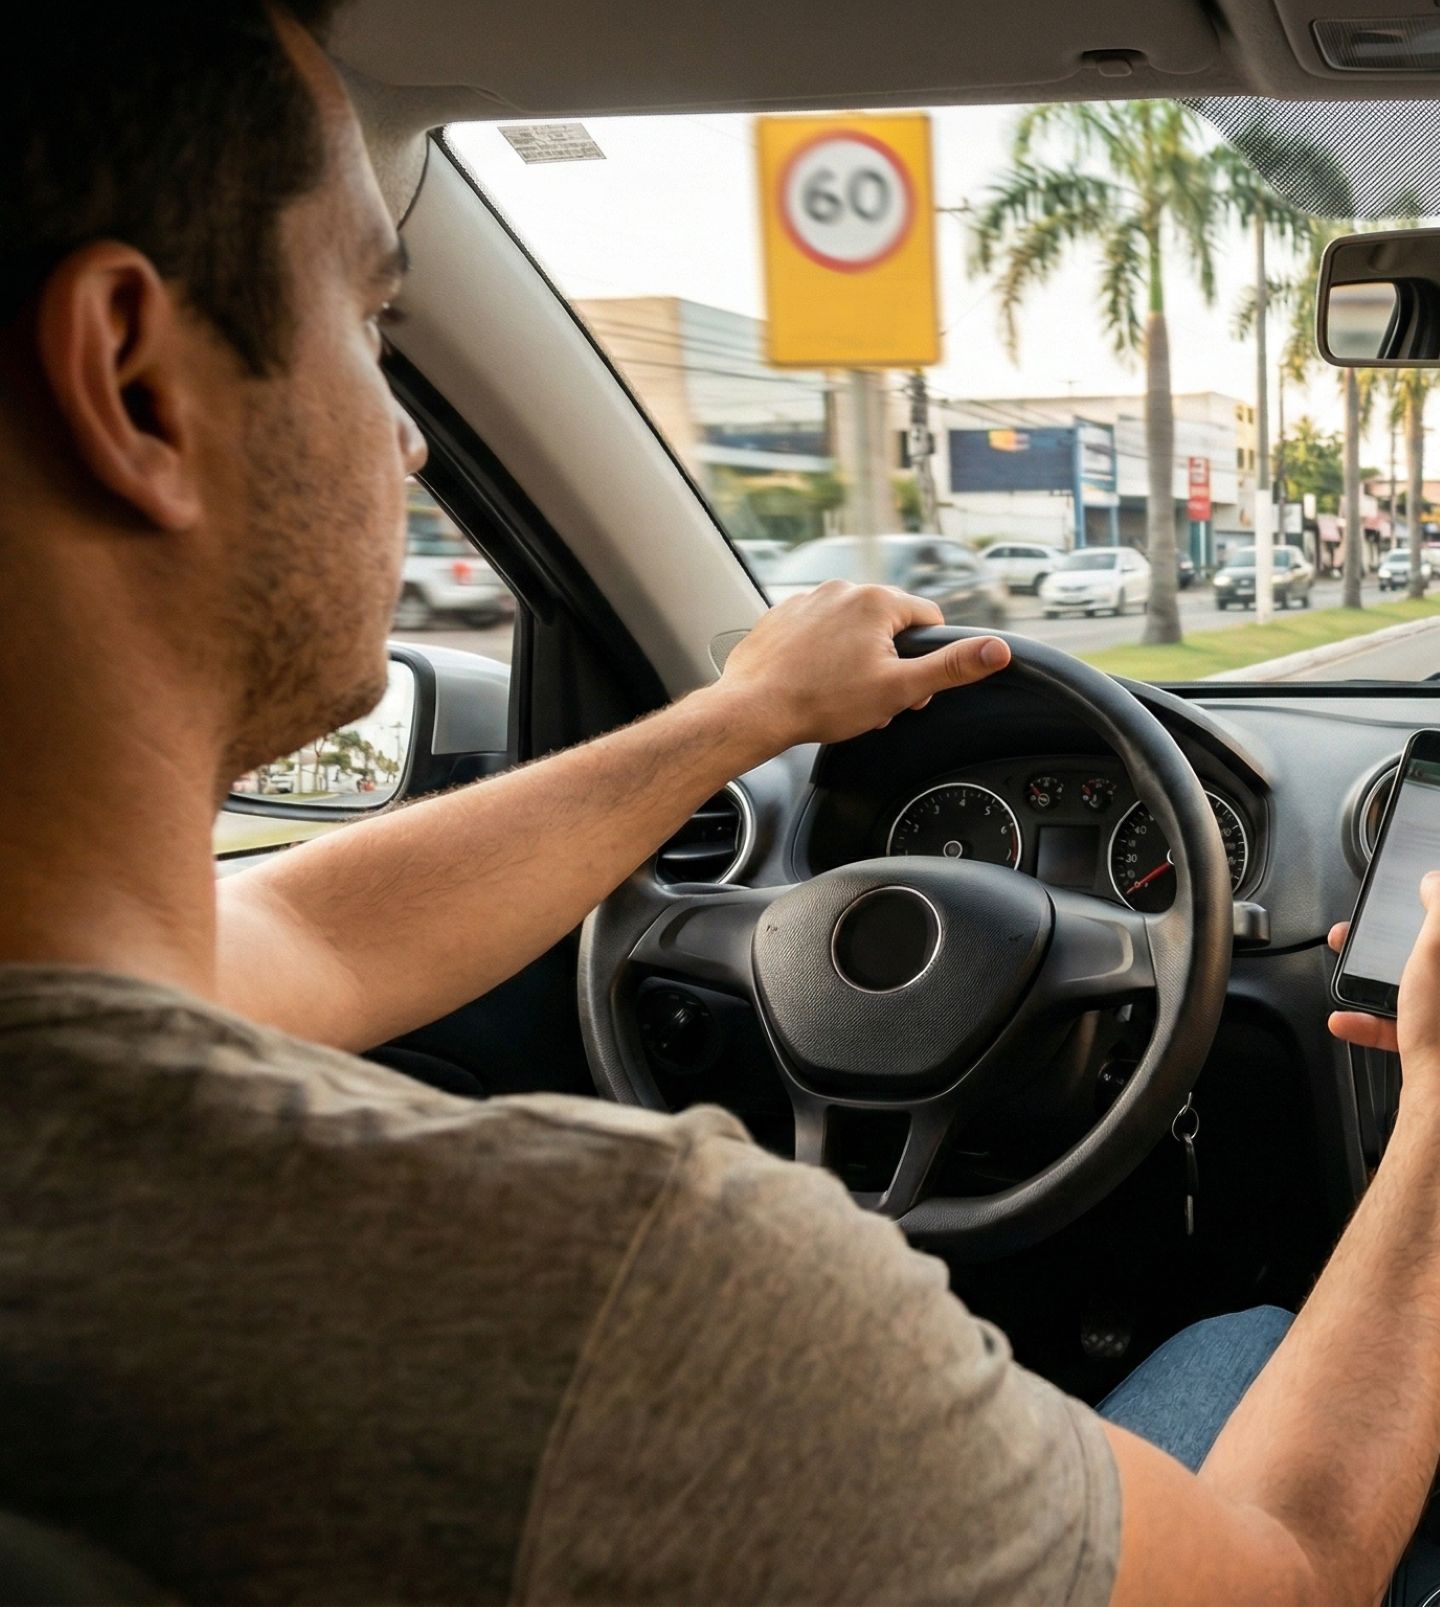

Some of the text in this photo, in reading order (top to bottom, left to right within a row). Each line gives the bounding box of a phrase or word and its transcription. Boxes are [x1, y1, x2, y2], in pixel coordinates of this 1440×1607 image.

[802, 167, 892, 225] 60
[984, 805, 991, 815] 5
[1000, 826, 1007, 834] 6
[1125, 853, 1138, 863] 30
